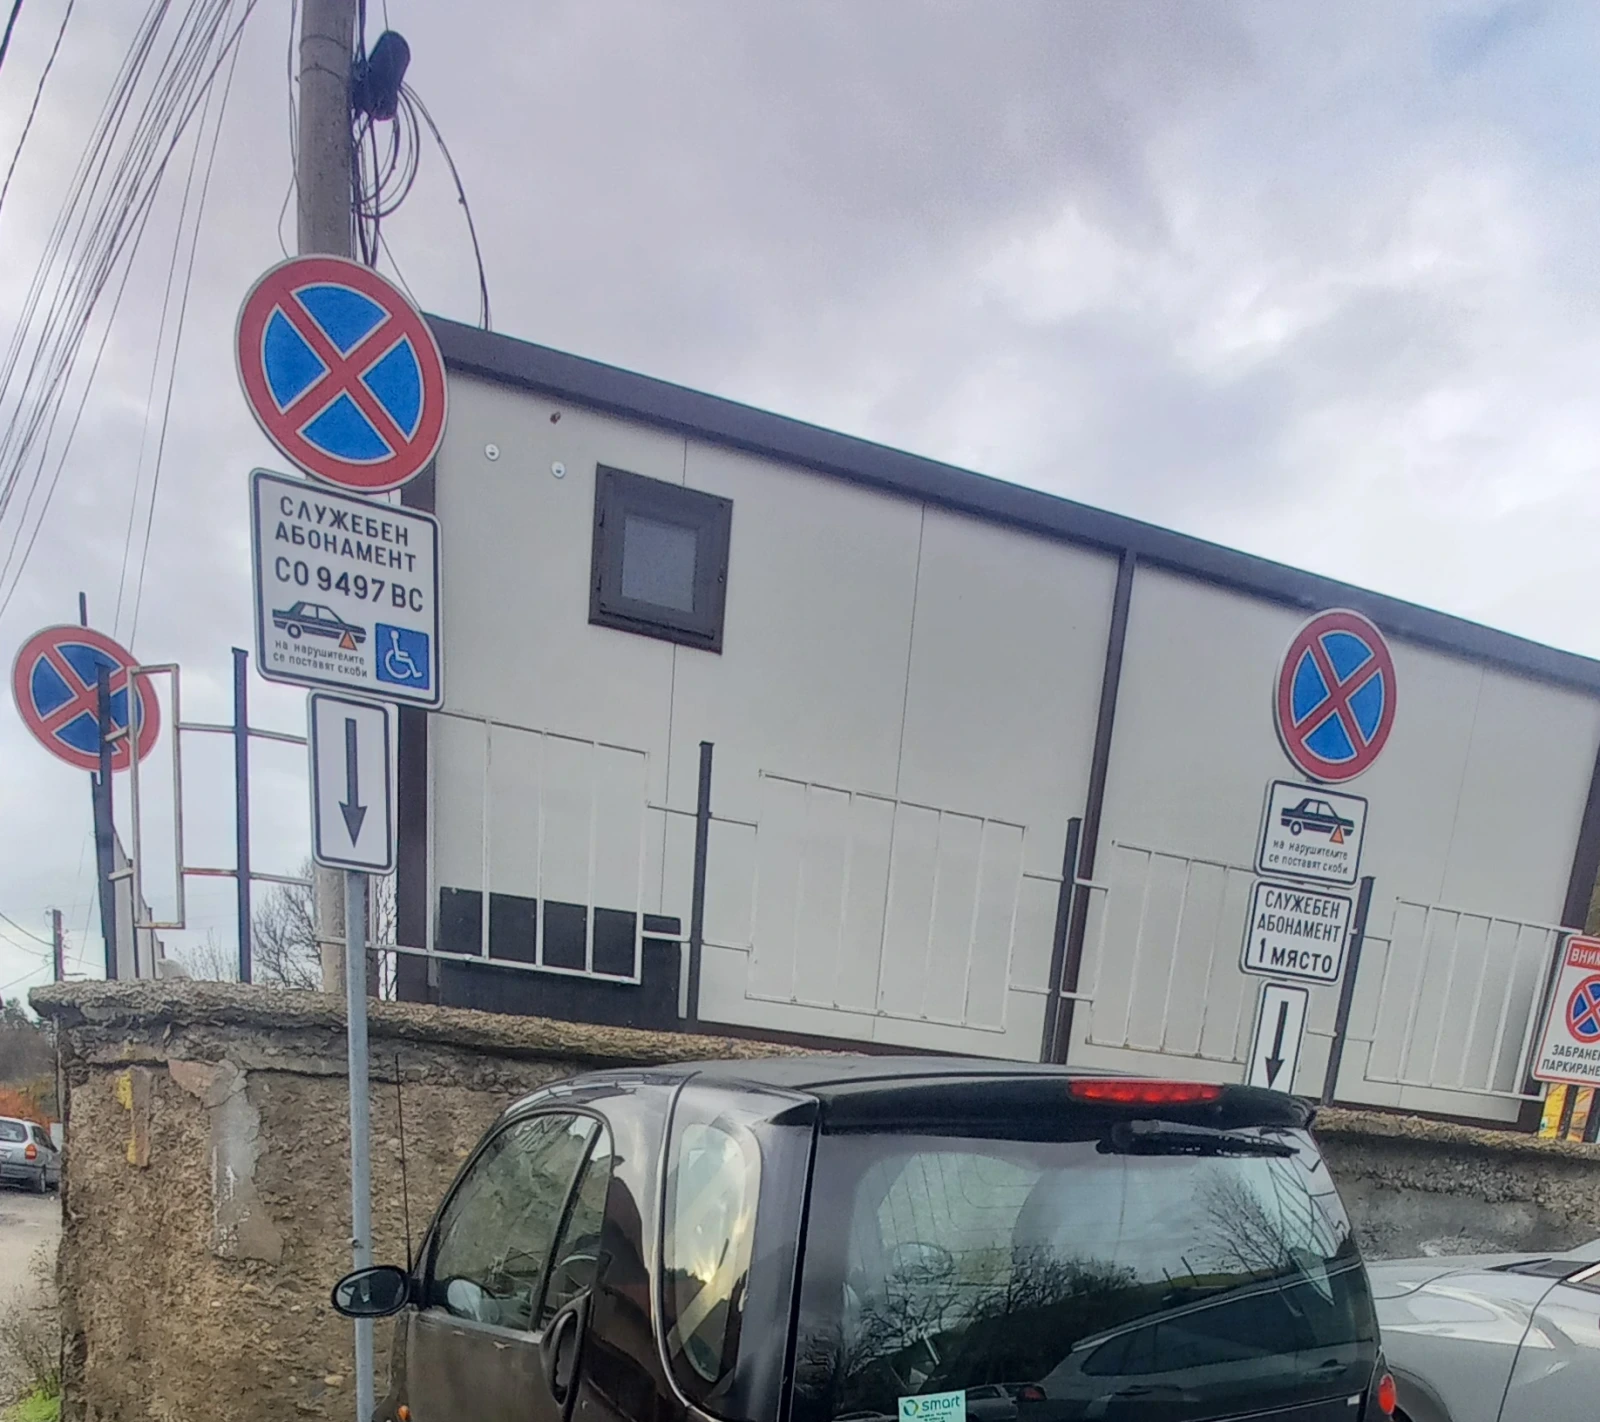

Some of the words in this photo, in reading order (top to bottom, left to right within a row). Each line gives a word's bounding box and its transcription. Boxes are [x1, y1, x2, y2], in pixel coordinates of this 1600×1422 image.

[280, 496, 408, 547] СЛУЖЕБЕН
[275, 521, 416, 573] АБОНАМЕНТ
[273, 652, 285, 662] се
[289, 655, 335, 671] поставят
[338, 664, 367, 678] скоби
[275, 640, 288, 650] на
[294, 643, 364, 665] нарушителите
[1273, 840, 1284, 849] на
[1268, 853, 1279, 863] се
[1282, 856, 1321, 869] поставят
[1265, 890, 1340, 919] СЛУЖЕБЕН
[1257, 913, 1341, 942] АБОНАМЕНТ
[1259, 937, 1266, 963] 1
[1270, 946, 1333, 973] МЯСТО
[922, 1395, 960, 1411] smart
